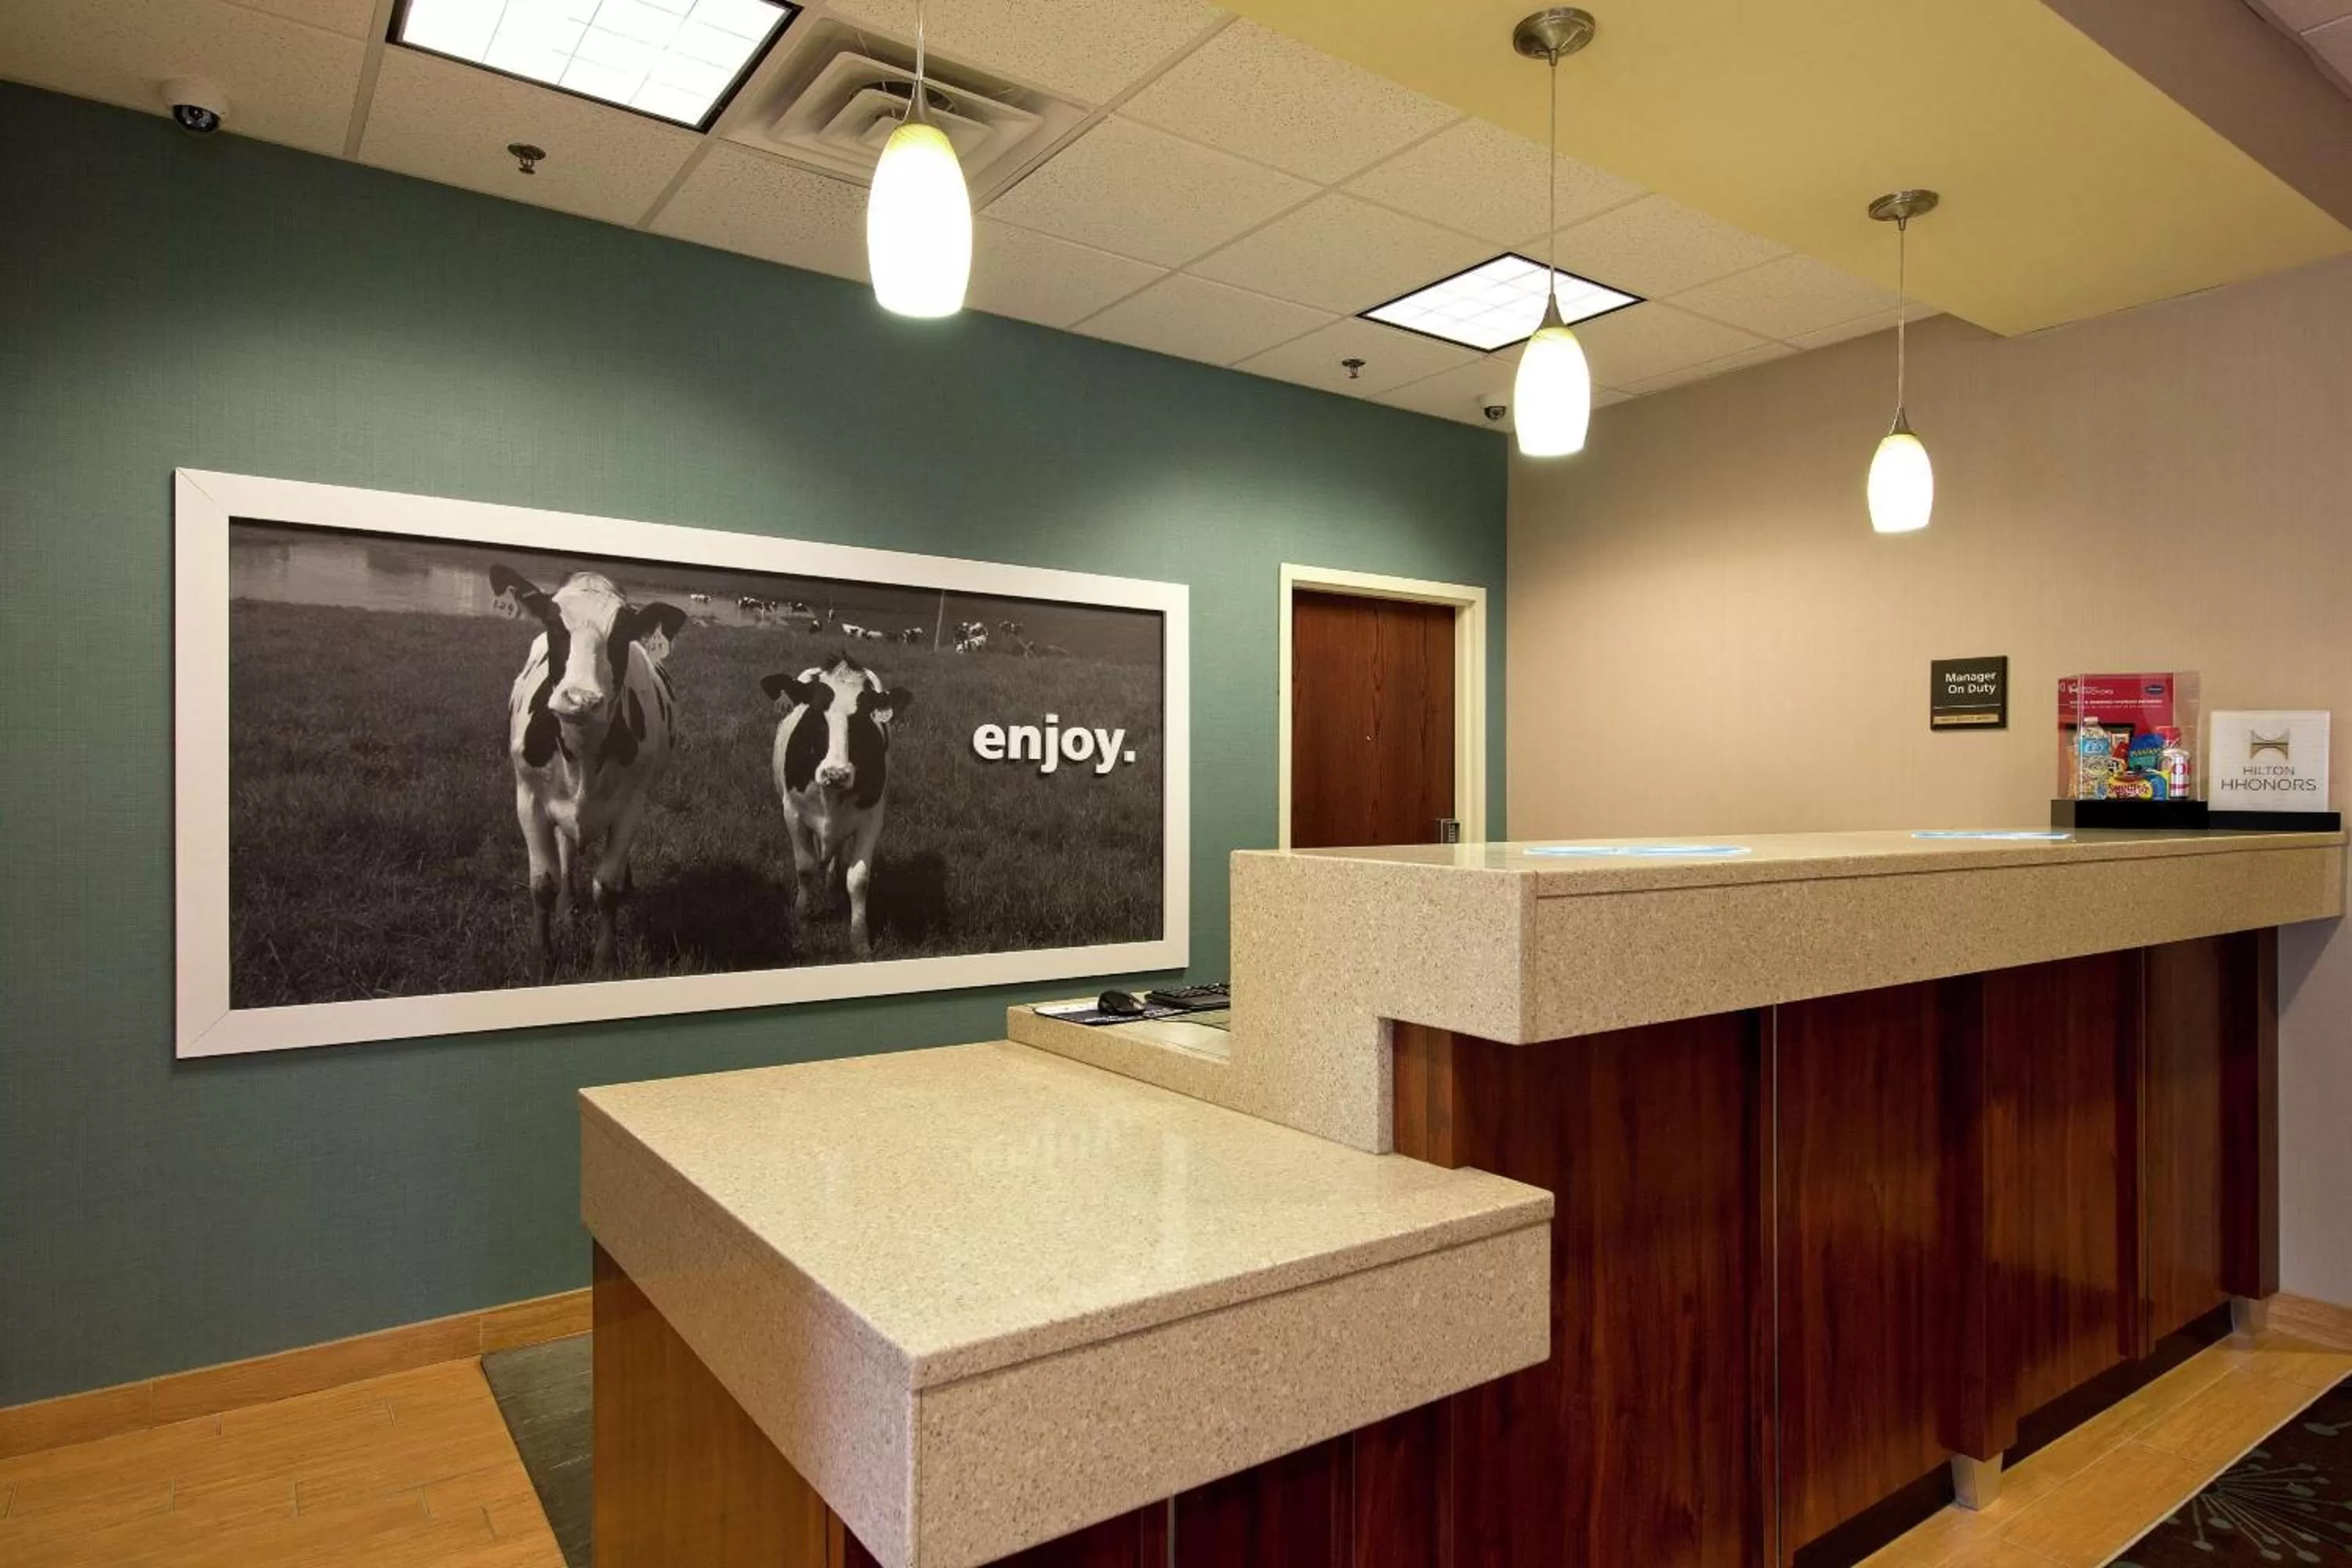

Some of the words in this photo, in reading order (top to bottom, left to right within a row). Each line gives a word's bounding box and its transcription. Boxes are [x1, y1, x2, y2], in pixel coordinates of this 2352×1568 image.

[1945, 672, 1996, 683] Manager
[1948, 684, 1964, 694] On
[1968, 683, 1996, 695] Duty
[973, 713, 1136, 774] enjoy.
[2243, 766, 2295, 775] HILTON
[2221, 779, 2317, 791] HHONORS
